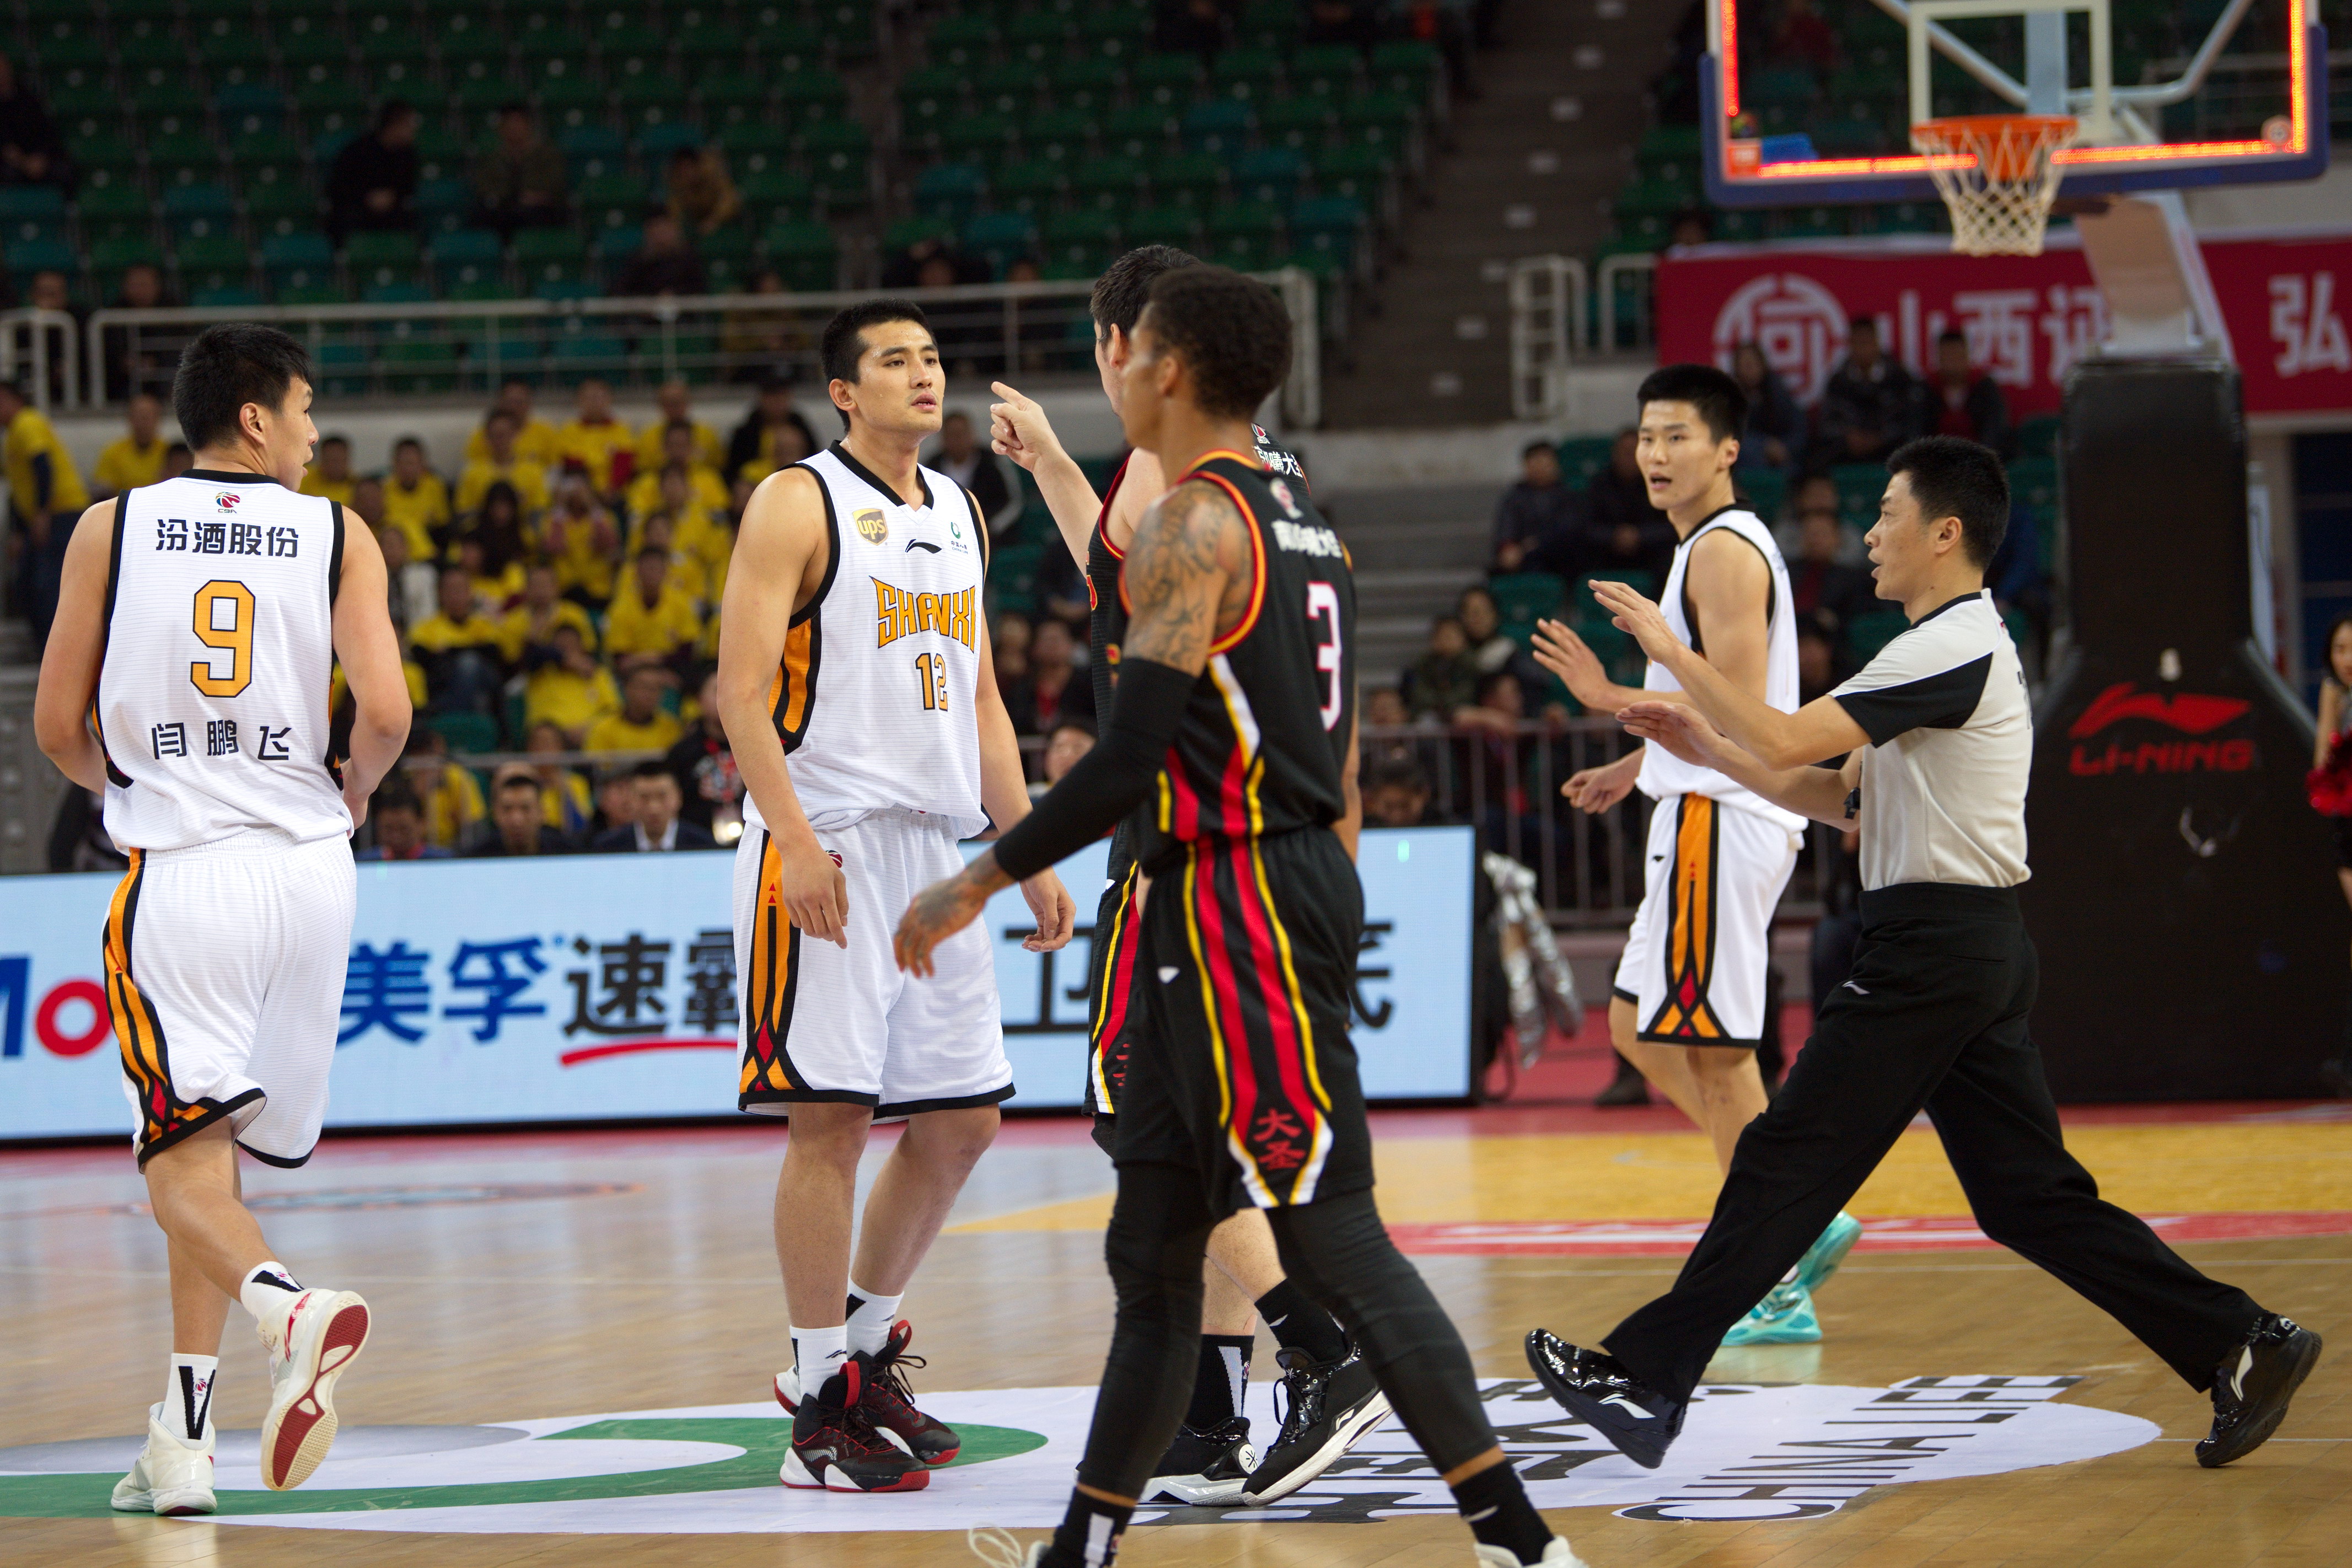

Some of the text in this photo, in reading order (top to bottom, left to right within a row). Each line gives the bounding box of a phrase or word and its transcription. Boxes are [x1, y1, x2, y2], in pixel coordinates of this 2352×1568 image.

[2268, 271, 2351, 378] 弘
[156, 519, 299, 558] 汾酒股份
[857, 519, 885, 539] ups
[190, 579, 255, 698] 9
[869, 576, 976, 654] SHANXI
[915, 653, 948, 712] 12
[1307, 582, 1342, 732] 3
[152, 719, 292, 760] 闫鹏飞
[2070, 739, 2256, 775] LI-NING
[1253, 1109, 1306, 1170] 大圣
[1621, 1377, 2086, 1522] CHINA LIFE
